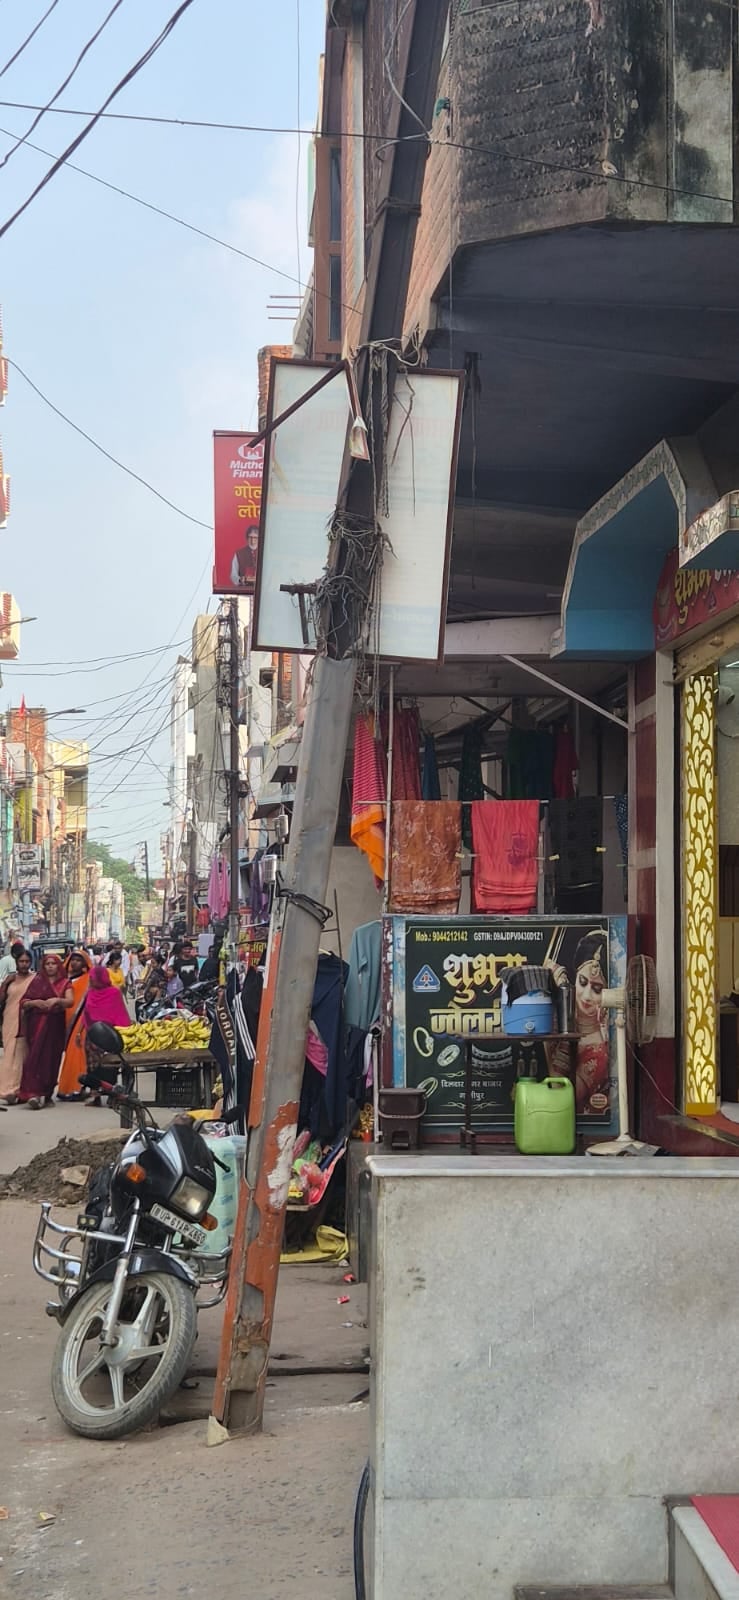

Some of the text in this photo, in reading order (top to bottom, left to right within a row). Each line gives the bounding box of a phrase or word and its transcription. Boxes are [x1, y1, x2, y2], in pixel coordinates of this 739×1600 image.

[230, 460, 263, 469] Mutho
[233, 469, 262, 478] Finan
[234, 480, 262, 499] गोल
[237, 499, 261, 518] लो
[473, 931, 492, 941] GSTIN:
[217, 1005, 236, 1056] JORDAN
[459, 1091, 485, 1101] गाीपुर
